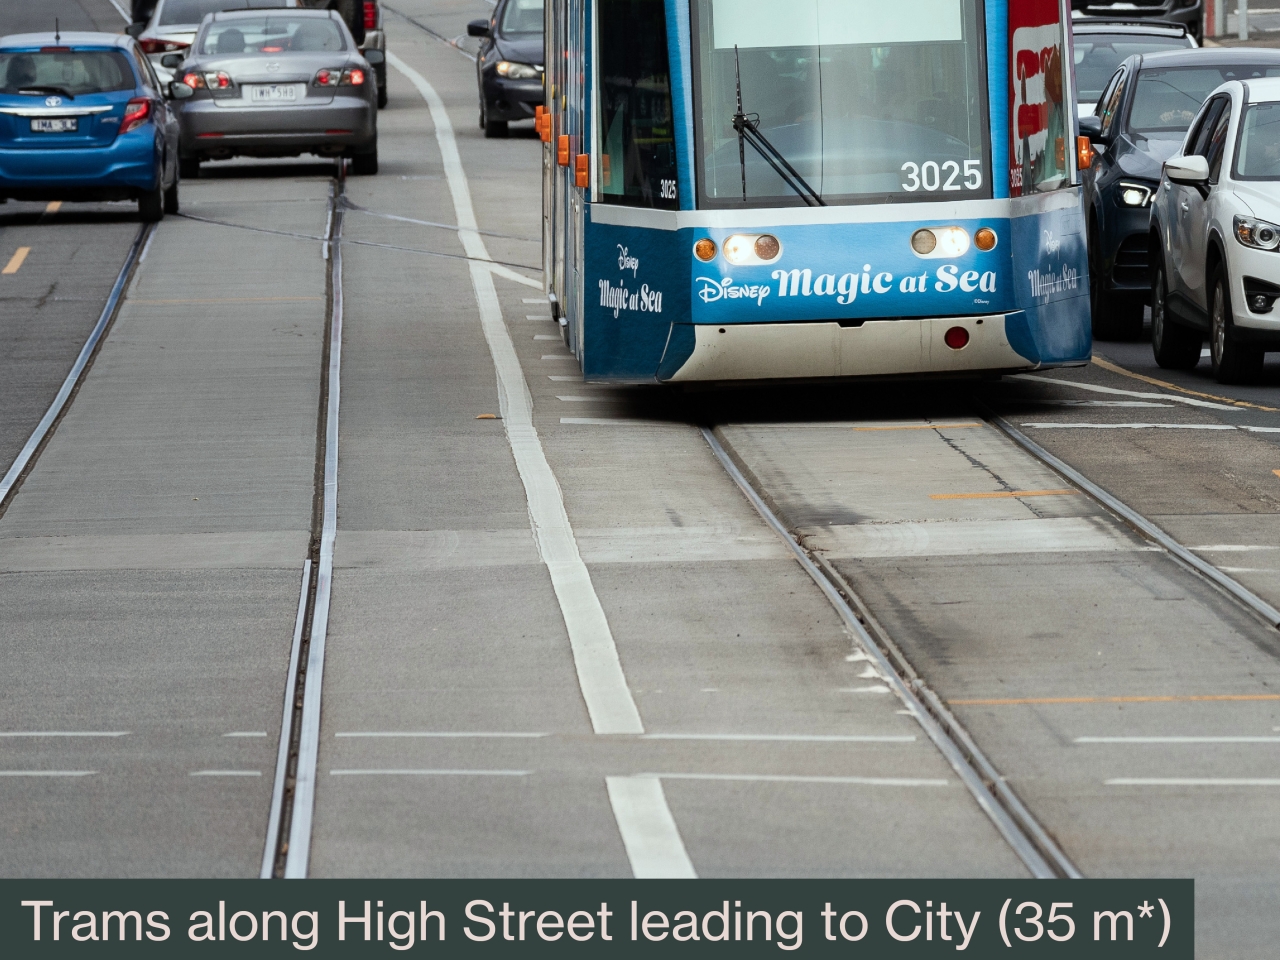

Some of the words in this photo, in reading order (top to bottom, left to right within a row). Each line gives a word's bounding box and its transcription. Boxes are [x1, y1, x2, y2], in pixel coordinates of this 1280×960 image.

[660, 178, 677, 200] 3025
[900, 159, 983, 192] 3025
[598, 279, 628, 319] Magic
[629, 289, 640, 312] at
[640, 283, 663, 314] Sea
[771, 263, 893, 305] Magic
[899, 270, 929, 294] at
[934, 264, 997, 293] Sea
